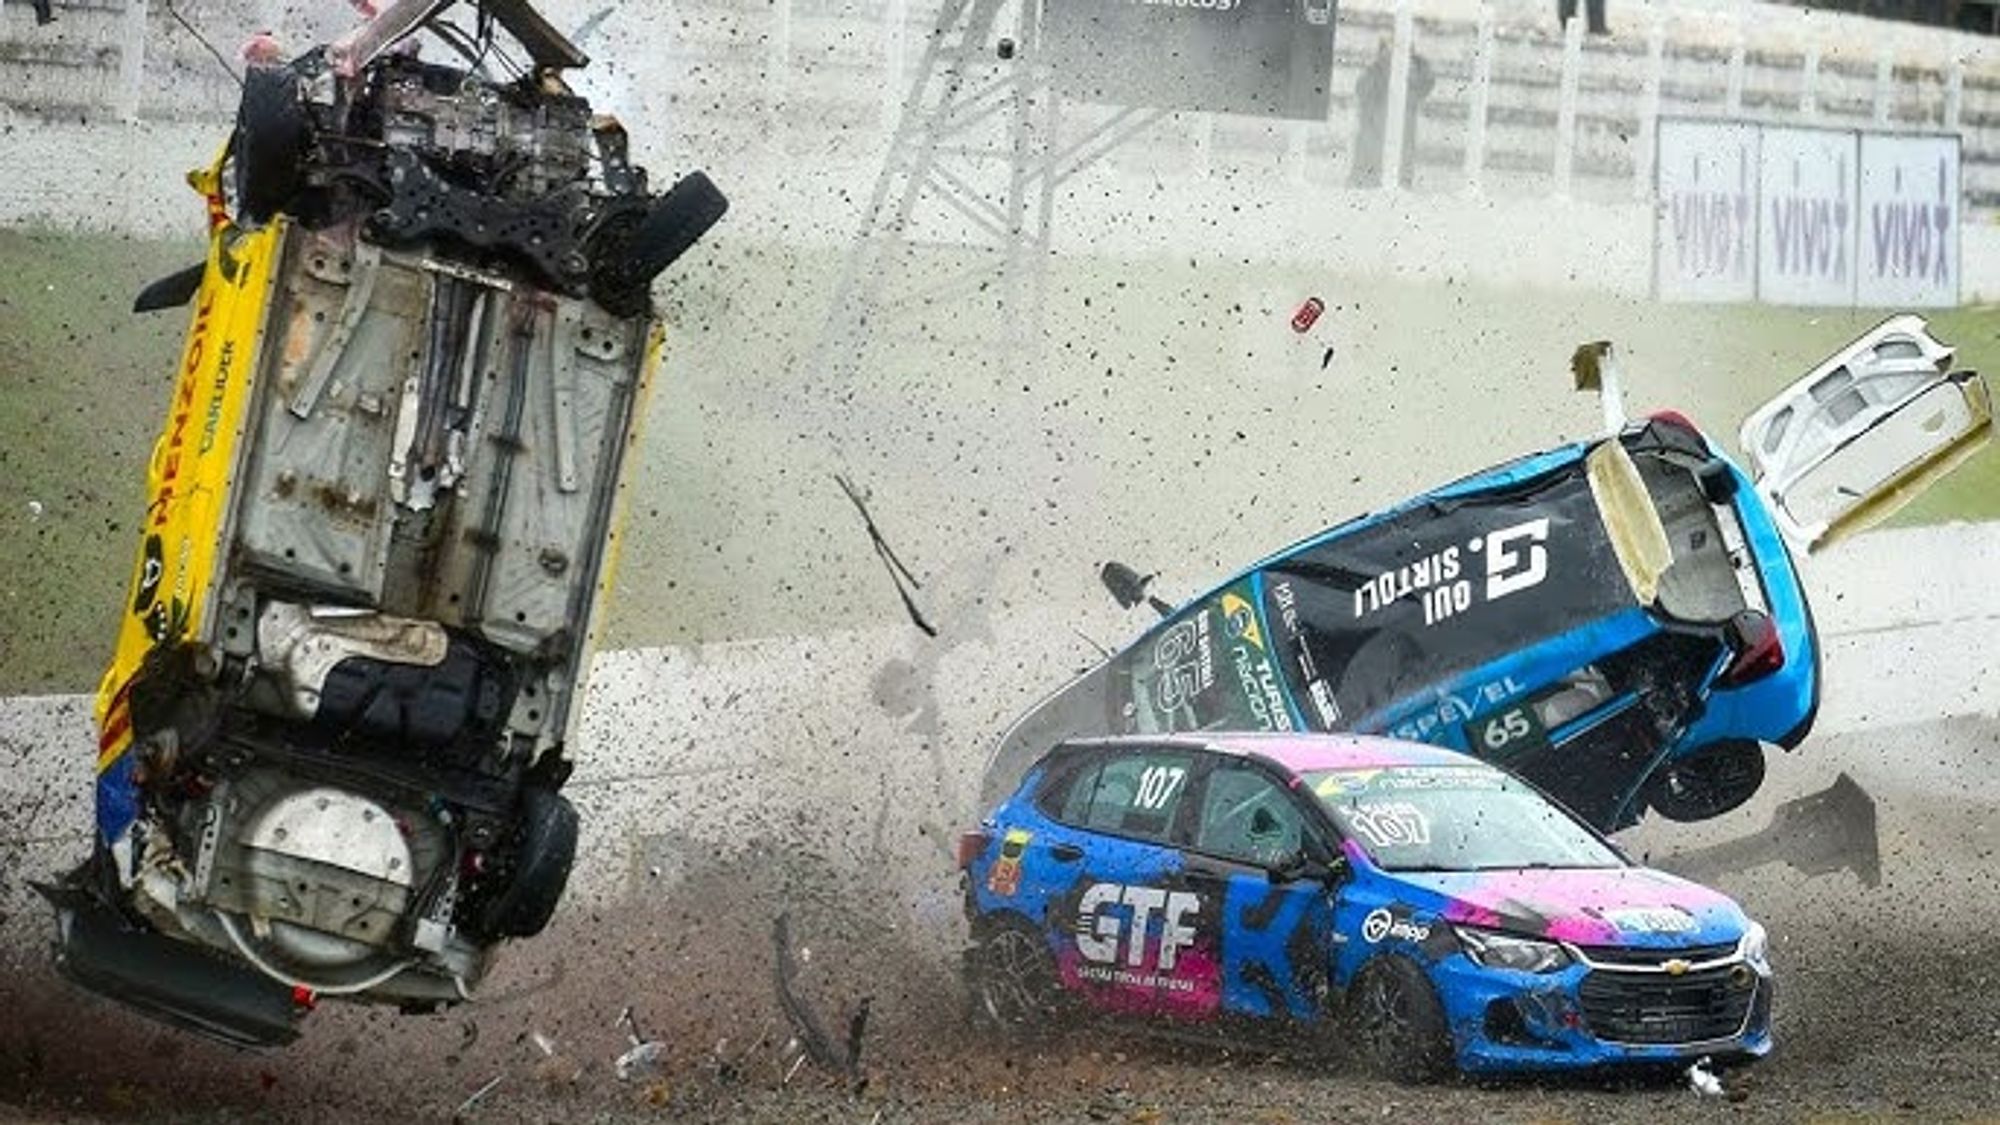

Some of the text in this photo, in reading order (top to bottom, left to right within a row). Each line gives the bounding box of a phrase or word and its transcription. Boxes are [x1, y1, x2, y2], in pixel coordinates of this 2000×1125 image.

[154, 291, 214, 526] MENZOIL
[1354, 544, 1461, 617] SIRTOLI
[1424, 578, 1472, 626] GUI
[1152, 621, 1200, 711] 65
[1252, 657, 1293, 731] TURIS
[1483, 707, 1531, 750] 65
[1133, 766, 1183, 810] 107
[1351, 806, 1431, 847] 107
[1074, 882, 1201, 970] GTF
